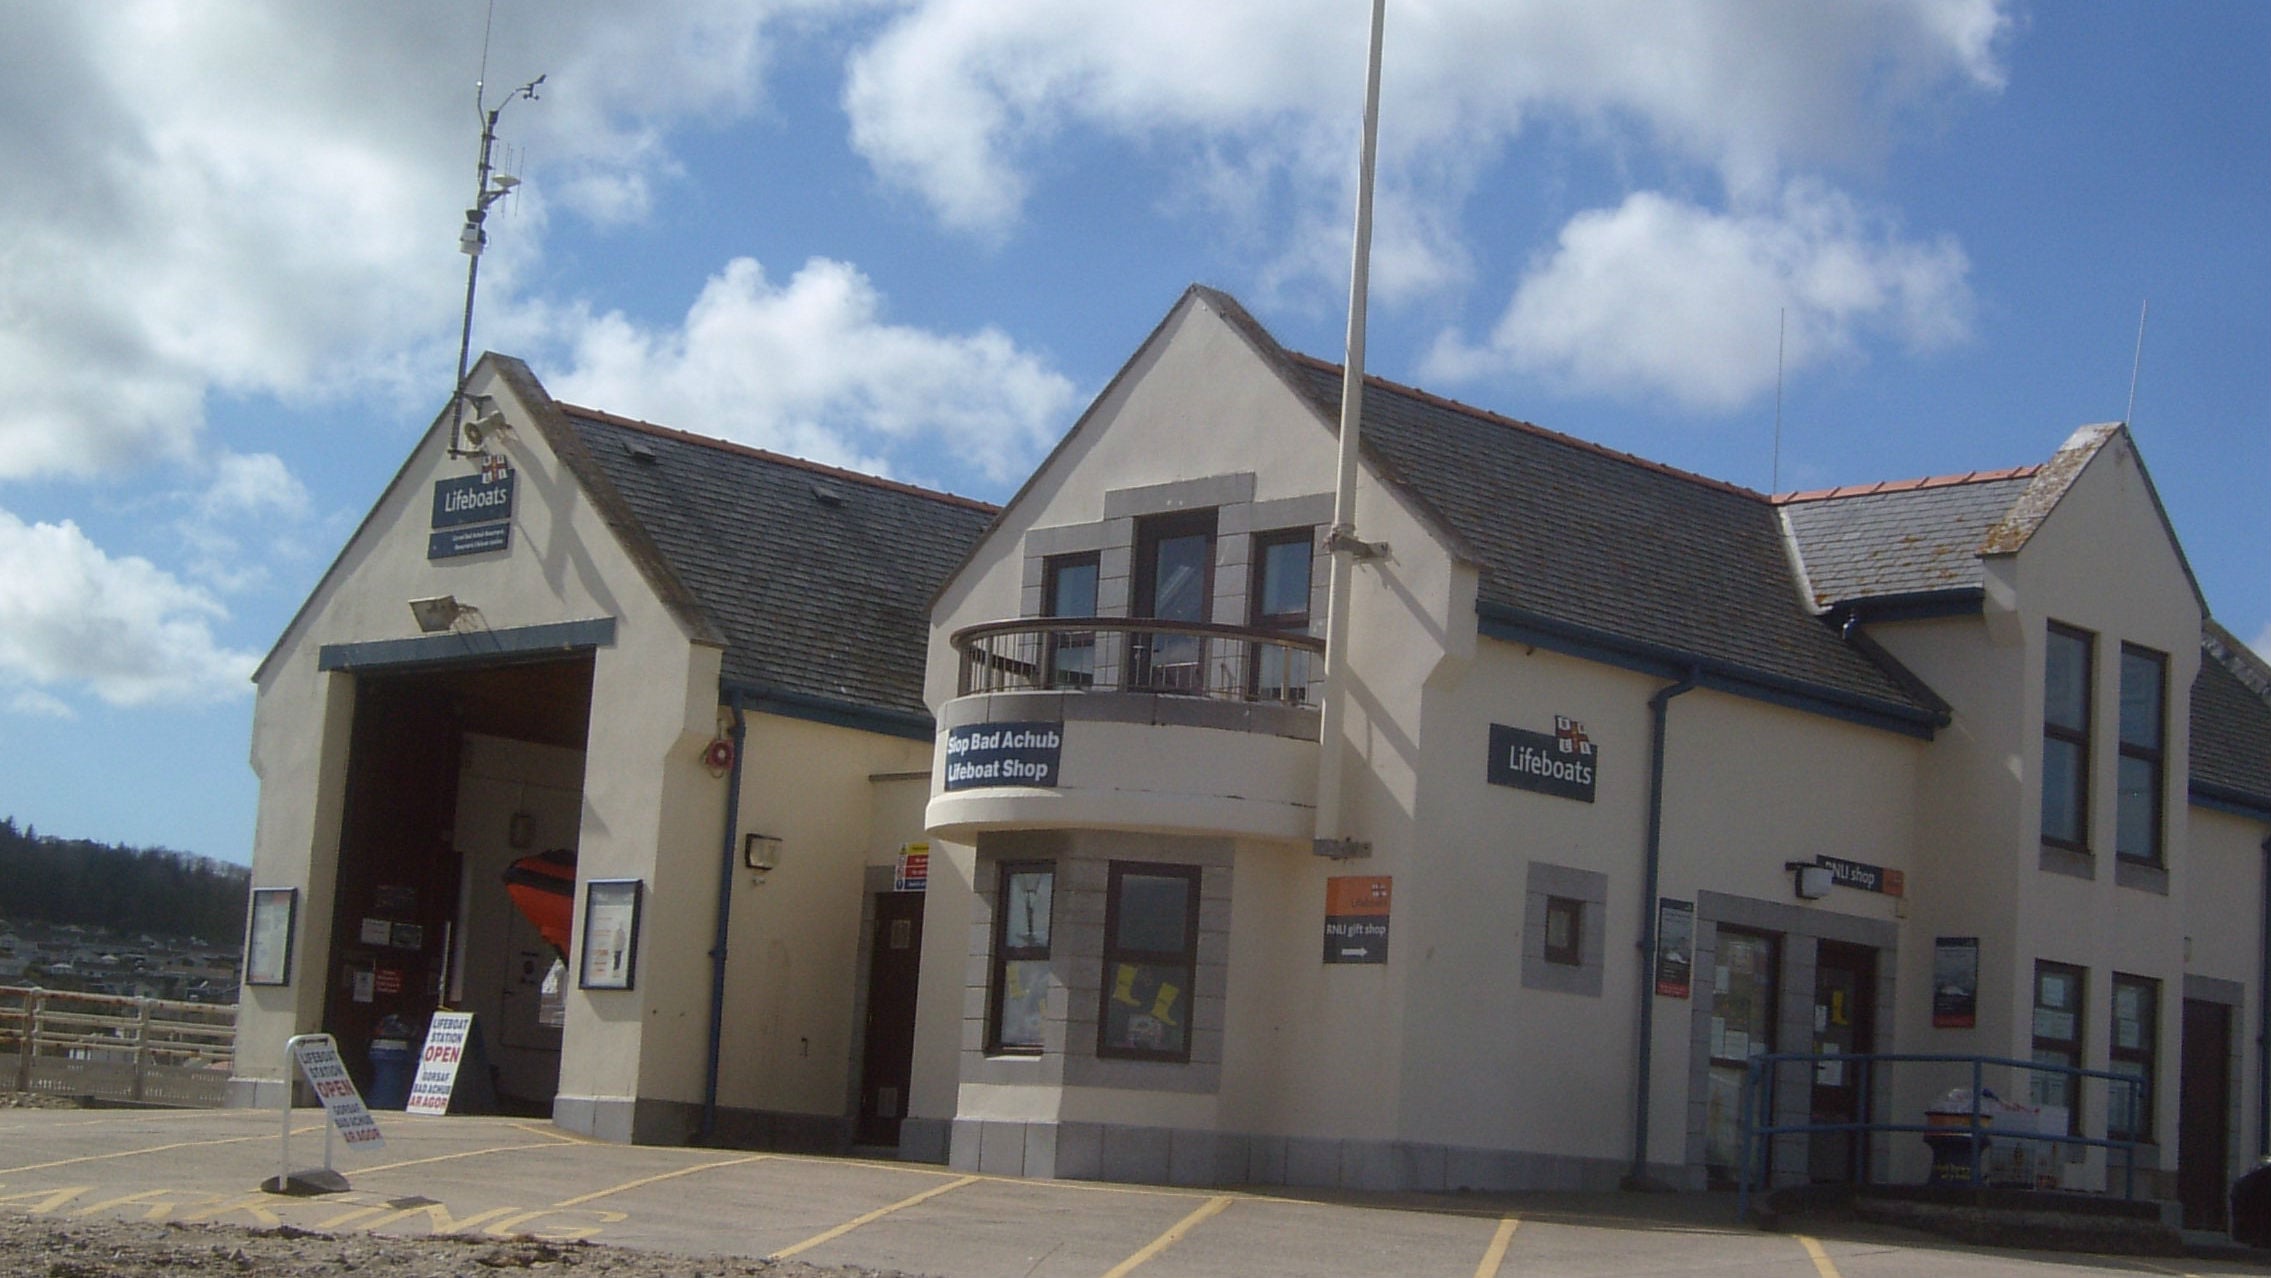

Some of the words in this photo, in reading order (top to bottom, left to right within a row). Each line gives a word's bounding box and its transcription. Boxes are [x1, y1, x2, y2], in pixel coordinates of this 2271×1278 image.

[444, 487, 507, 512] Lifeboats
[971, 732, 1000, 750] Bad
[1001, 730, 1060, 749] Achub
[948, 759, 1000, 782] Lifeboat
[1002, 759, 1048, 781] Shop
[1509, 745, 1592, 785] Lifeboats
[1851, 866, 1875, 889] shop
[1326, 923, 1346, 935] RNLI
[1347, 922, 1364, 938] gift
[1364, 922, 1386, 936] shop
[432, 1018, 468, 1029] LIFEBOAT
[431, 1032, 463, 1043] STATION
[302, 1050, 336, 1064] LIFEBOAT
[424, 1045, 461, 1063] OPEN
[309, 1064, 343, 1079] STATION
[316, 1080, 355, 1098] OPEN
[409, 1095, 423, 1107] AR
[423, 1096, 448, 1109] AGOR
[0, 1185, 628, 1239] ARKING
